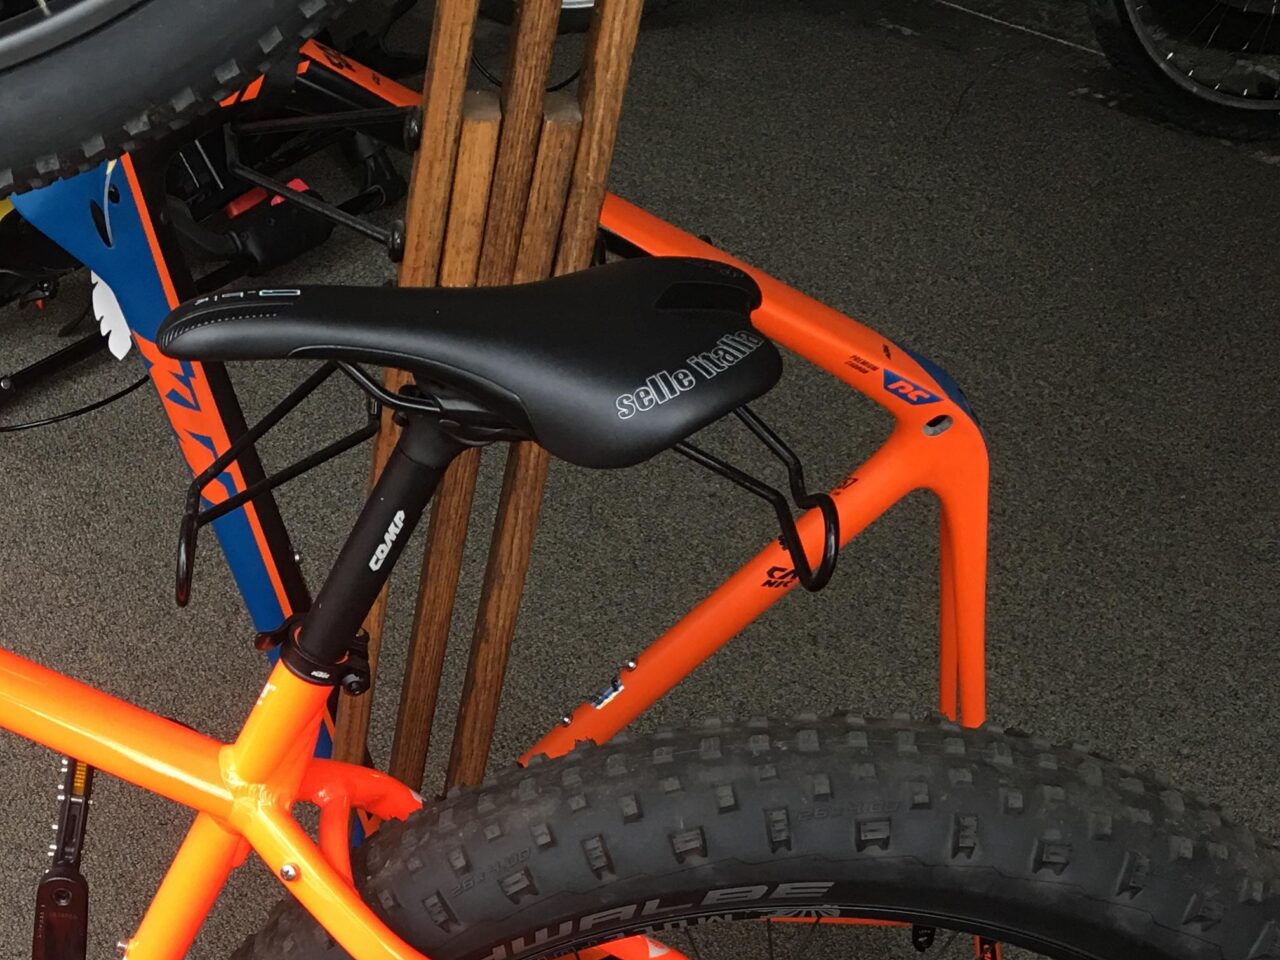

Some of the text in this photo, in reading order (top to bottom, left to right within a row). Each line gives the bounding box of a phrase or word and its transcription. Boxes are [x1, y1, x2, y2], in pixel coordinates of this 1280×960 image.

[615, 330, 766, 420] selle italia
[369, 510, 406, 572] COMP
